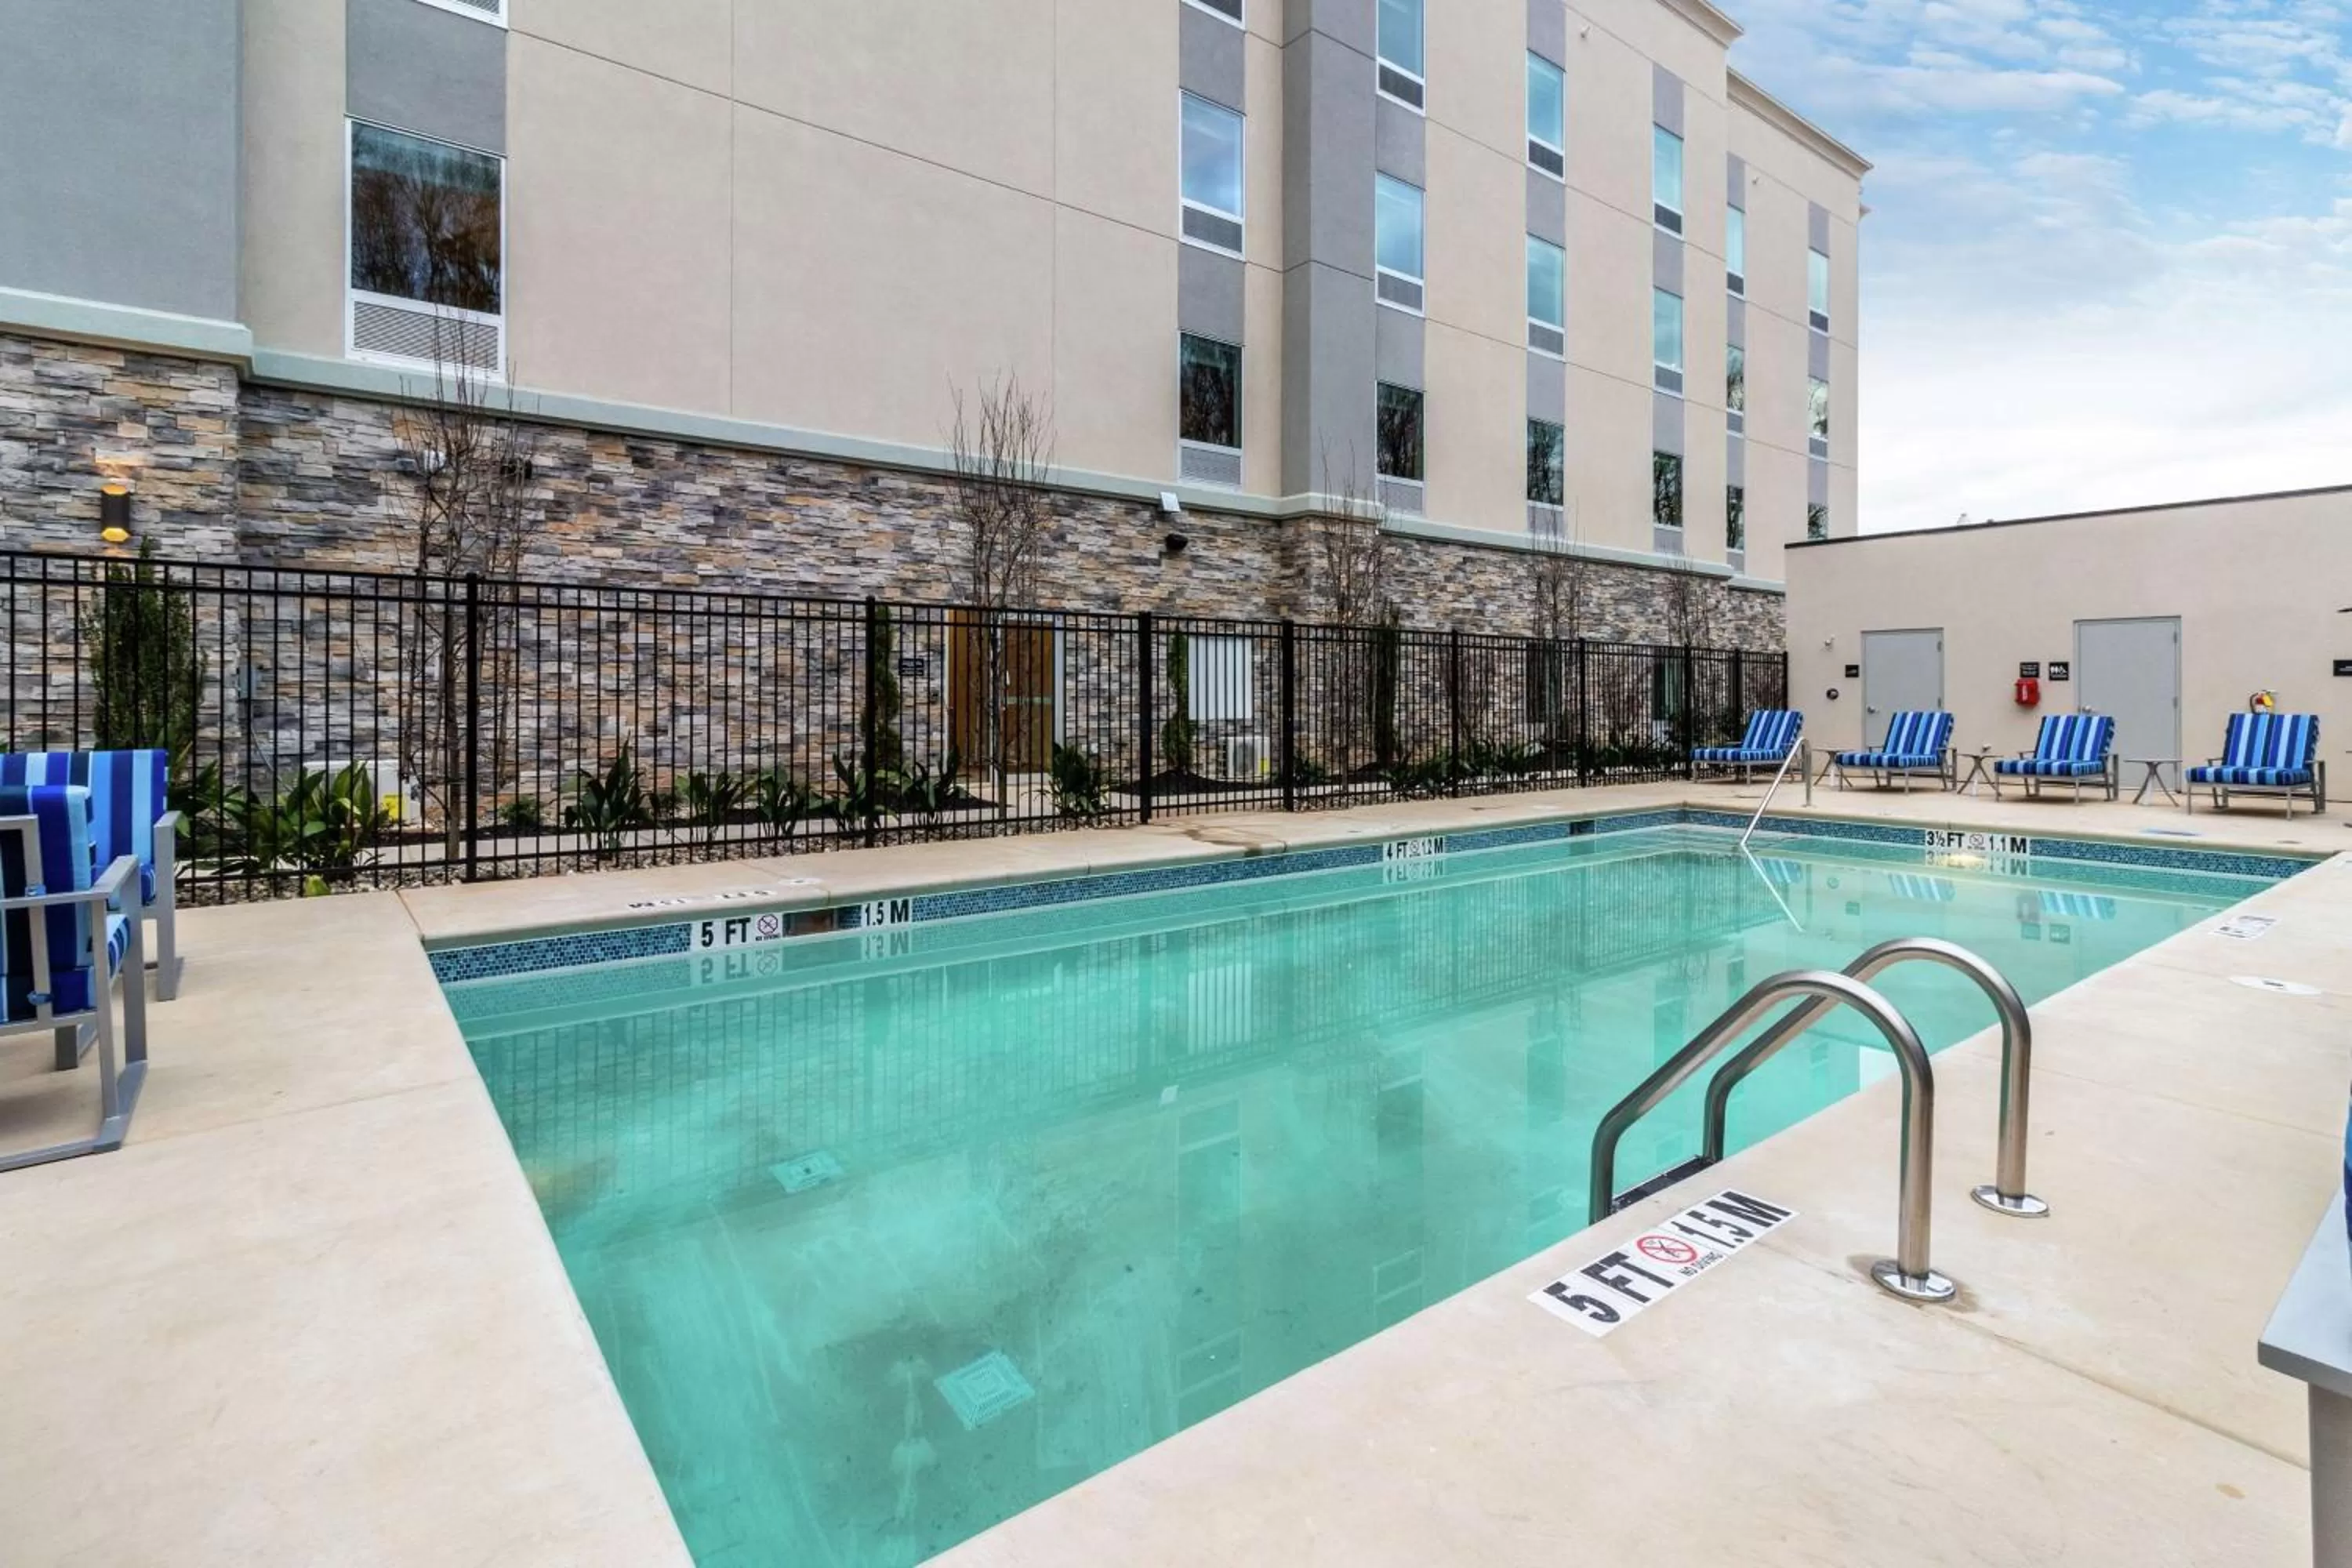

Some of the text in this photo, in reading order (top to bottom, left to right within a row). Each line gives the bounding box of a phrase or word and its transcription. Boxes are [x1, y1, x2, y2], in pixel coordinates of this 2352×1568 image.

[1396, 841, 1407, 858] FT
[1435, 837, 1443, 854] M
[1947, 832, 1965, 848] FT
[1989, 834, 2005, 851] 1.1
[2010, 837, 2027, 854] M
[865, 899, 909, 927] 1.5 M
[700, 916, 751, 948] 5 FT
[1543, 1191, 1792, 1323] 5 FT 1.5 M
